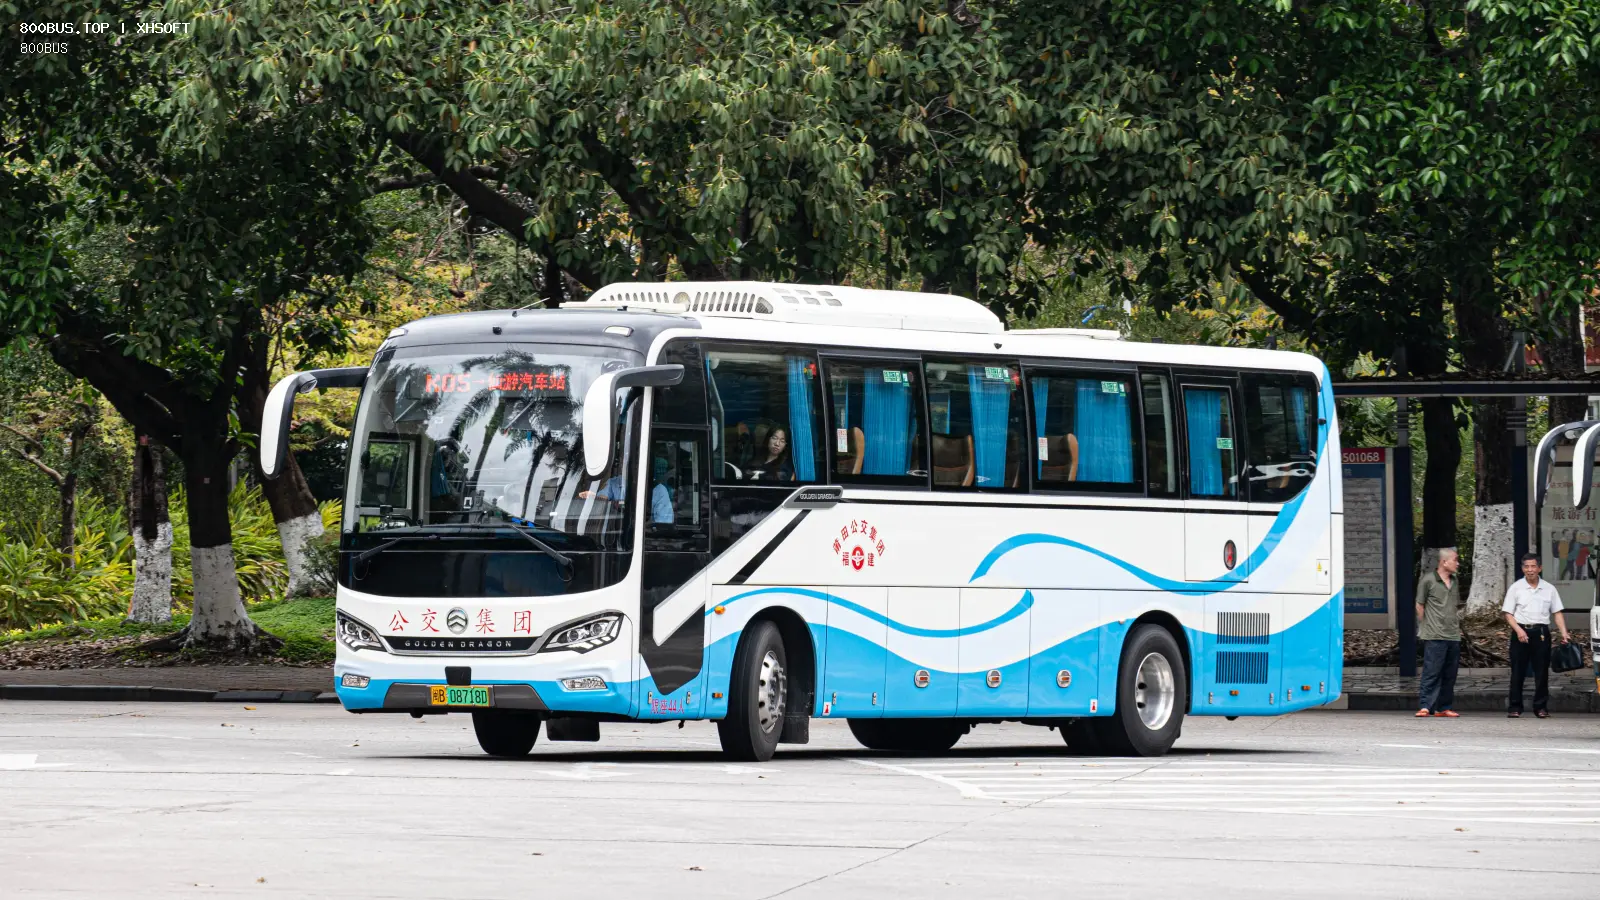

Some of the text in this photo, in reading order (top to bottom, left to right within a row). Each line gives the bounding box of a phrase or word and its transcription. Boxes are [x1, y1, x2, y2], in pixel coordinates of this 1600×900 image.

[1342, 452, 1380, 463] 501068
[388, 608, 532, 635] 公交集团
[404, 640, 512, 648] GOLDEN DRAGON
